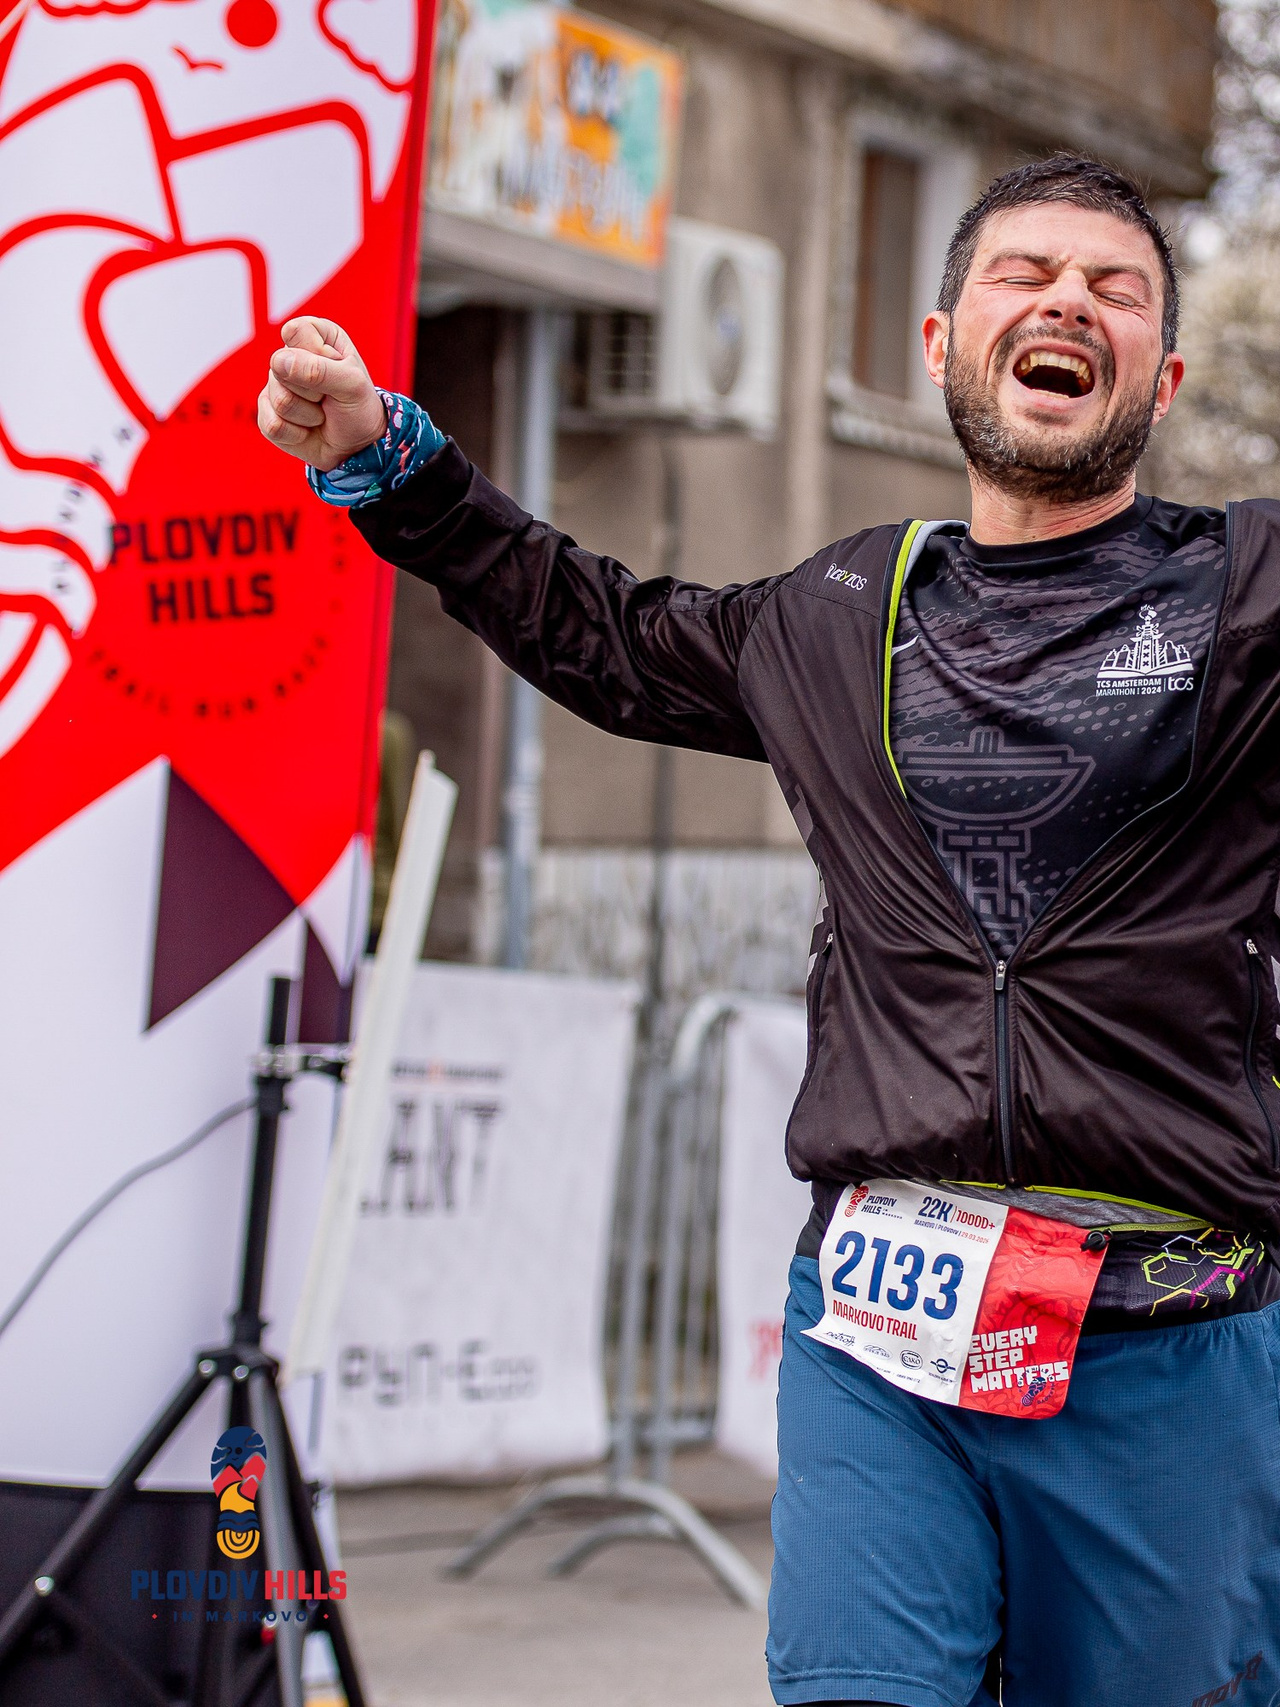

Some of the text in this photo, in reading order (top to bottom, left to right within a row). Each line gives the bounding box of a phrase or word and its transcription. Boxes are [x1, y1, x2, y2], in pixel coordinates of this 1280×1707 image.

[109, 508, 300, 567] PLOVDIV
[149, 572, 275, 626] HILLS
[1095, 686, 1161, 697] MARATHON 2024
[1096, 678, 1161, 689] TCS AMSTERDAM
[861, 1204, 882, 1215] HILLS
[866, 1195, 897, 1207] PLOVDIV
[917, 1196, 954, 1223] 22K
[831, 1230, 964, 1321] 2133
[832, 1299, 918, 1341] MARKOVO TRAIL
[968, 1325, 1038, 1354] EVERY
[969, 1348, 1023, 1373] STEP
[970, 1361, 1070, 1393] MATTERS
